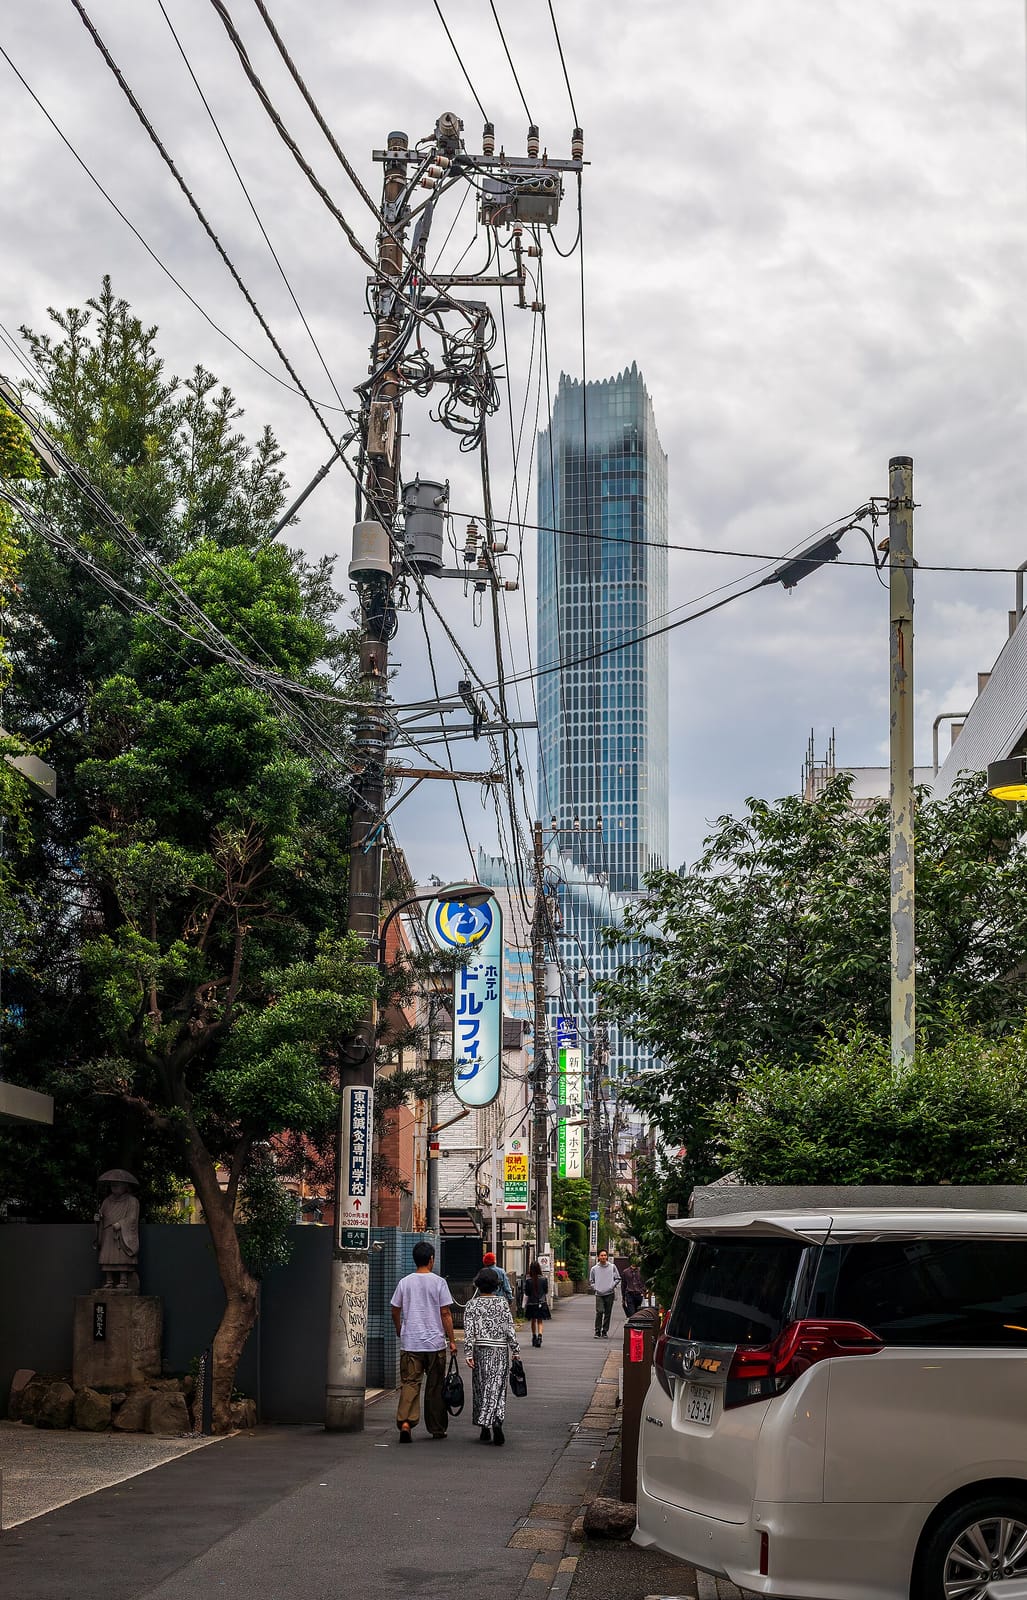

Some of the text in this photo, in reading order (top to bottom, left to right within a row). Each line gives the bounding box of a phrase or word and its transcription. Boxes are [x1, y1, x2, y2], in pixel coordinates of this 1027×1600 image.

[484, 964, 498, 1001] ホテル
[456, 963, 484, 1081] ドルフィン
[351, 1091, 366, 1195] 東洋鍼灸専門学校
[559, 1142, 567, 1167] HOTEL
[506, 1156, 522, 1164] 収納
[507, 1165, 526, 1173] スペース
